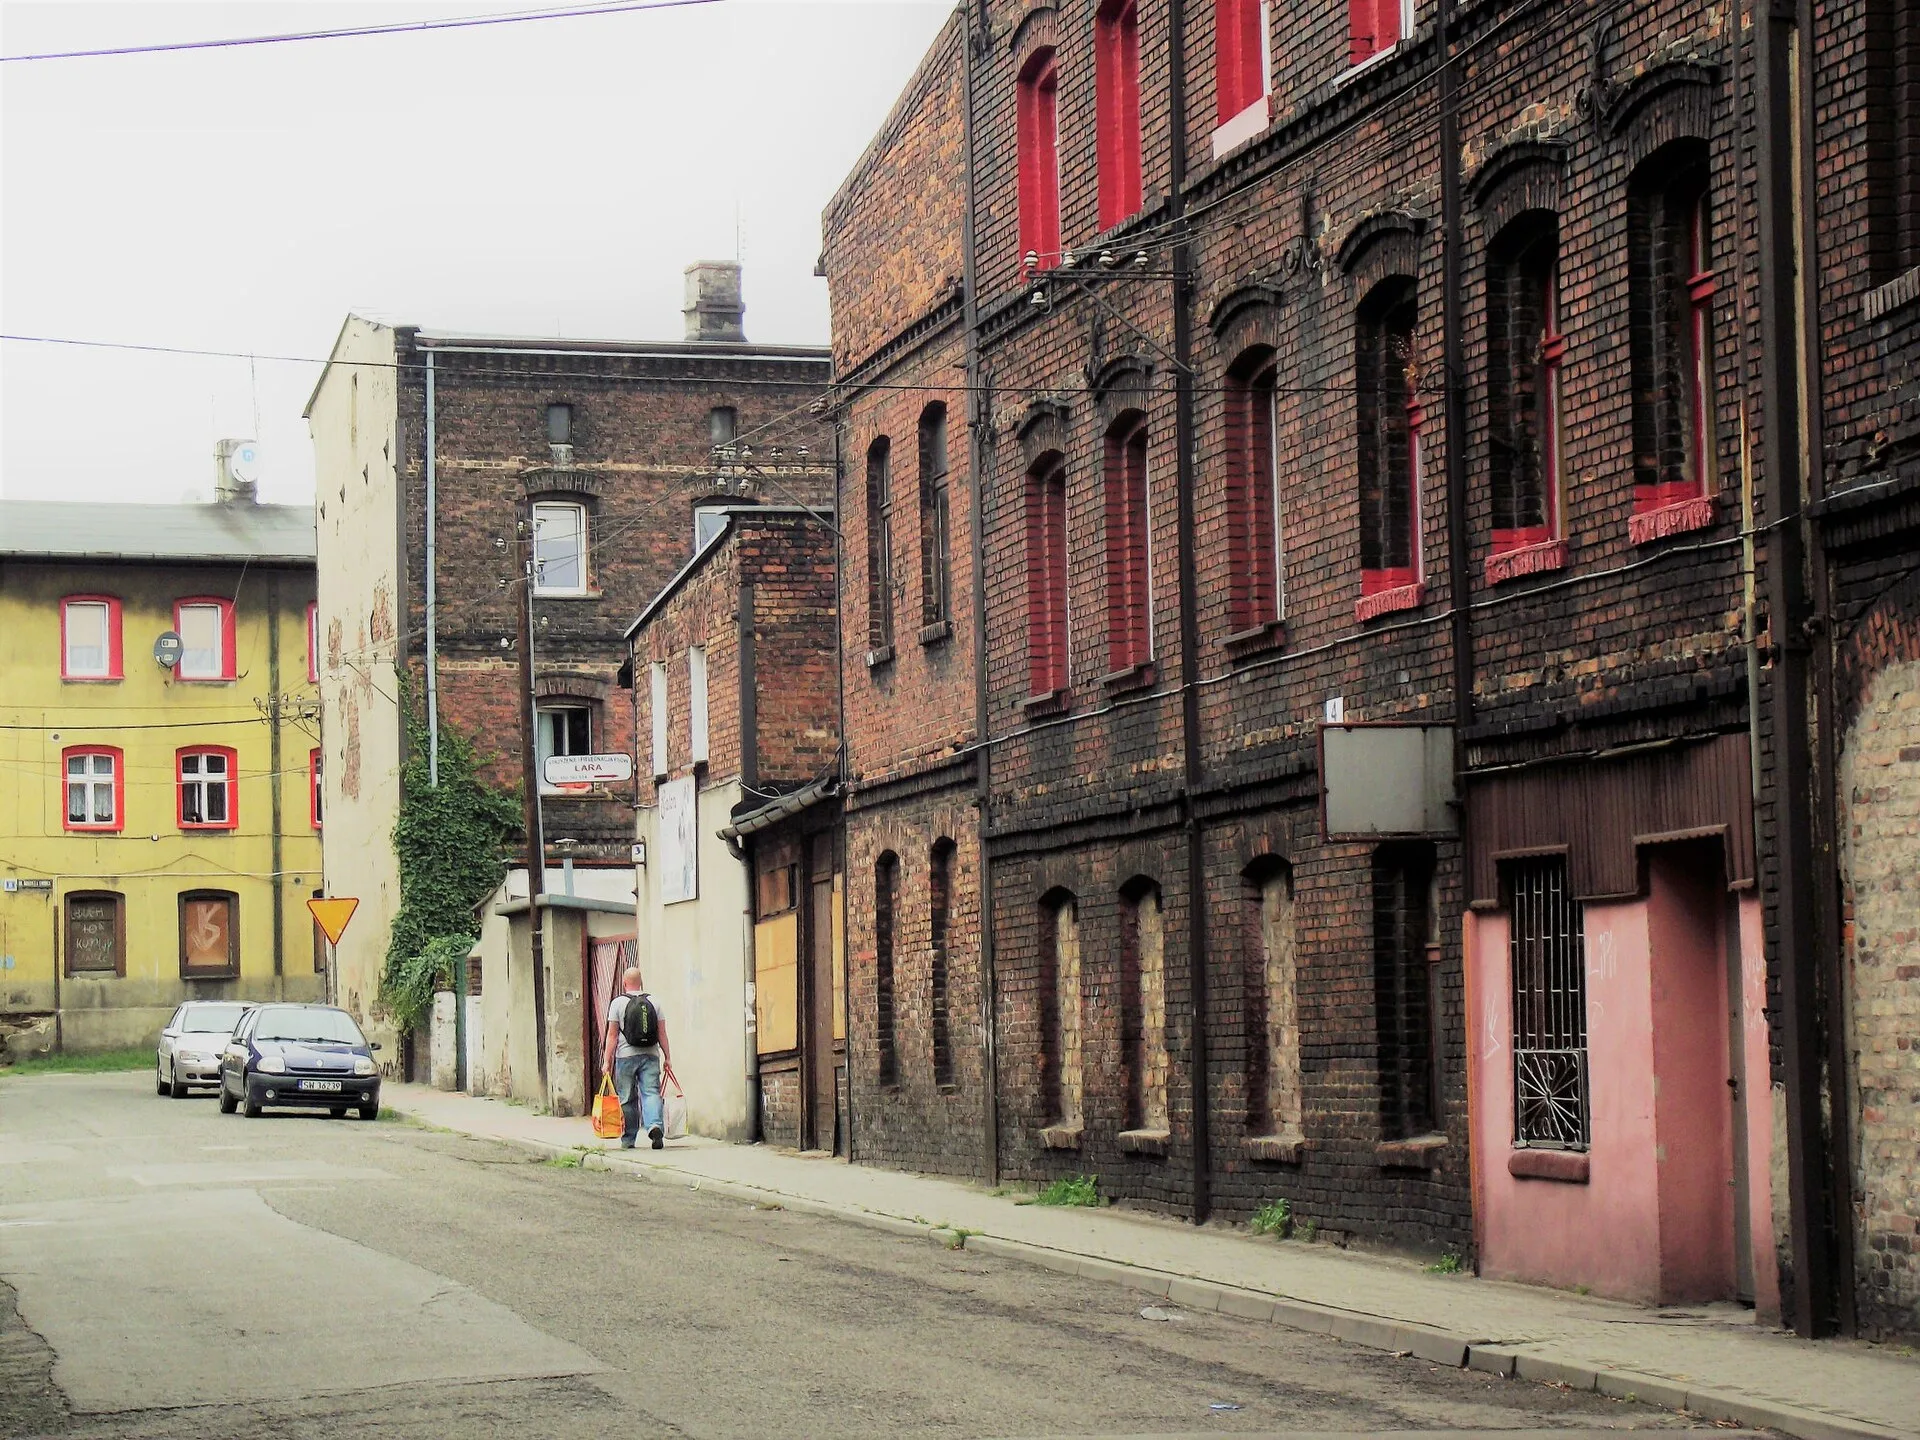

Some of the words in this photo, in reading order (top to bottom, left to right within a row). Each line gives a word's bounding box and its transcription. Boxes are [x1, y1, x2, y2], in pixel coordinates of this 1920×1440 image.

[1331, 701, 1337, 722] 4
[574, 764, 602, 772] LARA
[635, 846, 641, 855] 3
